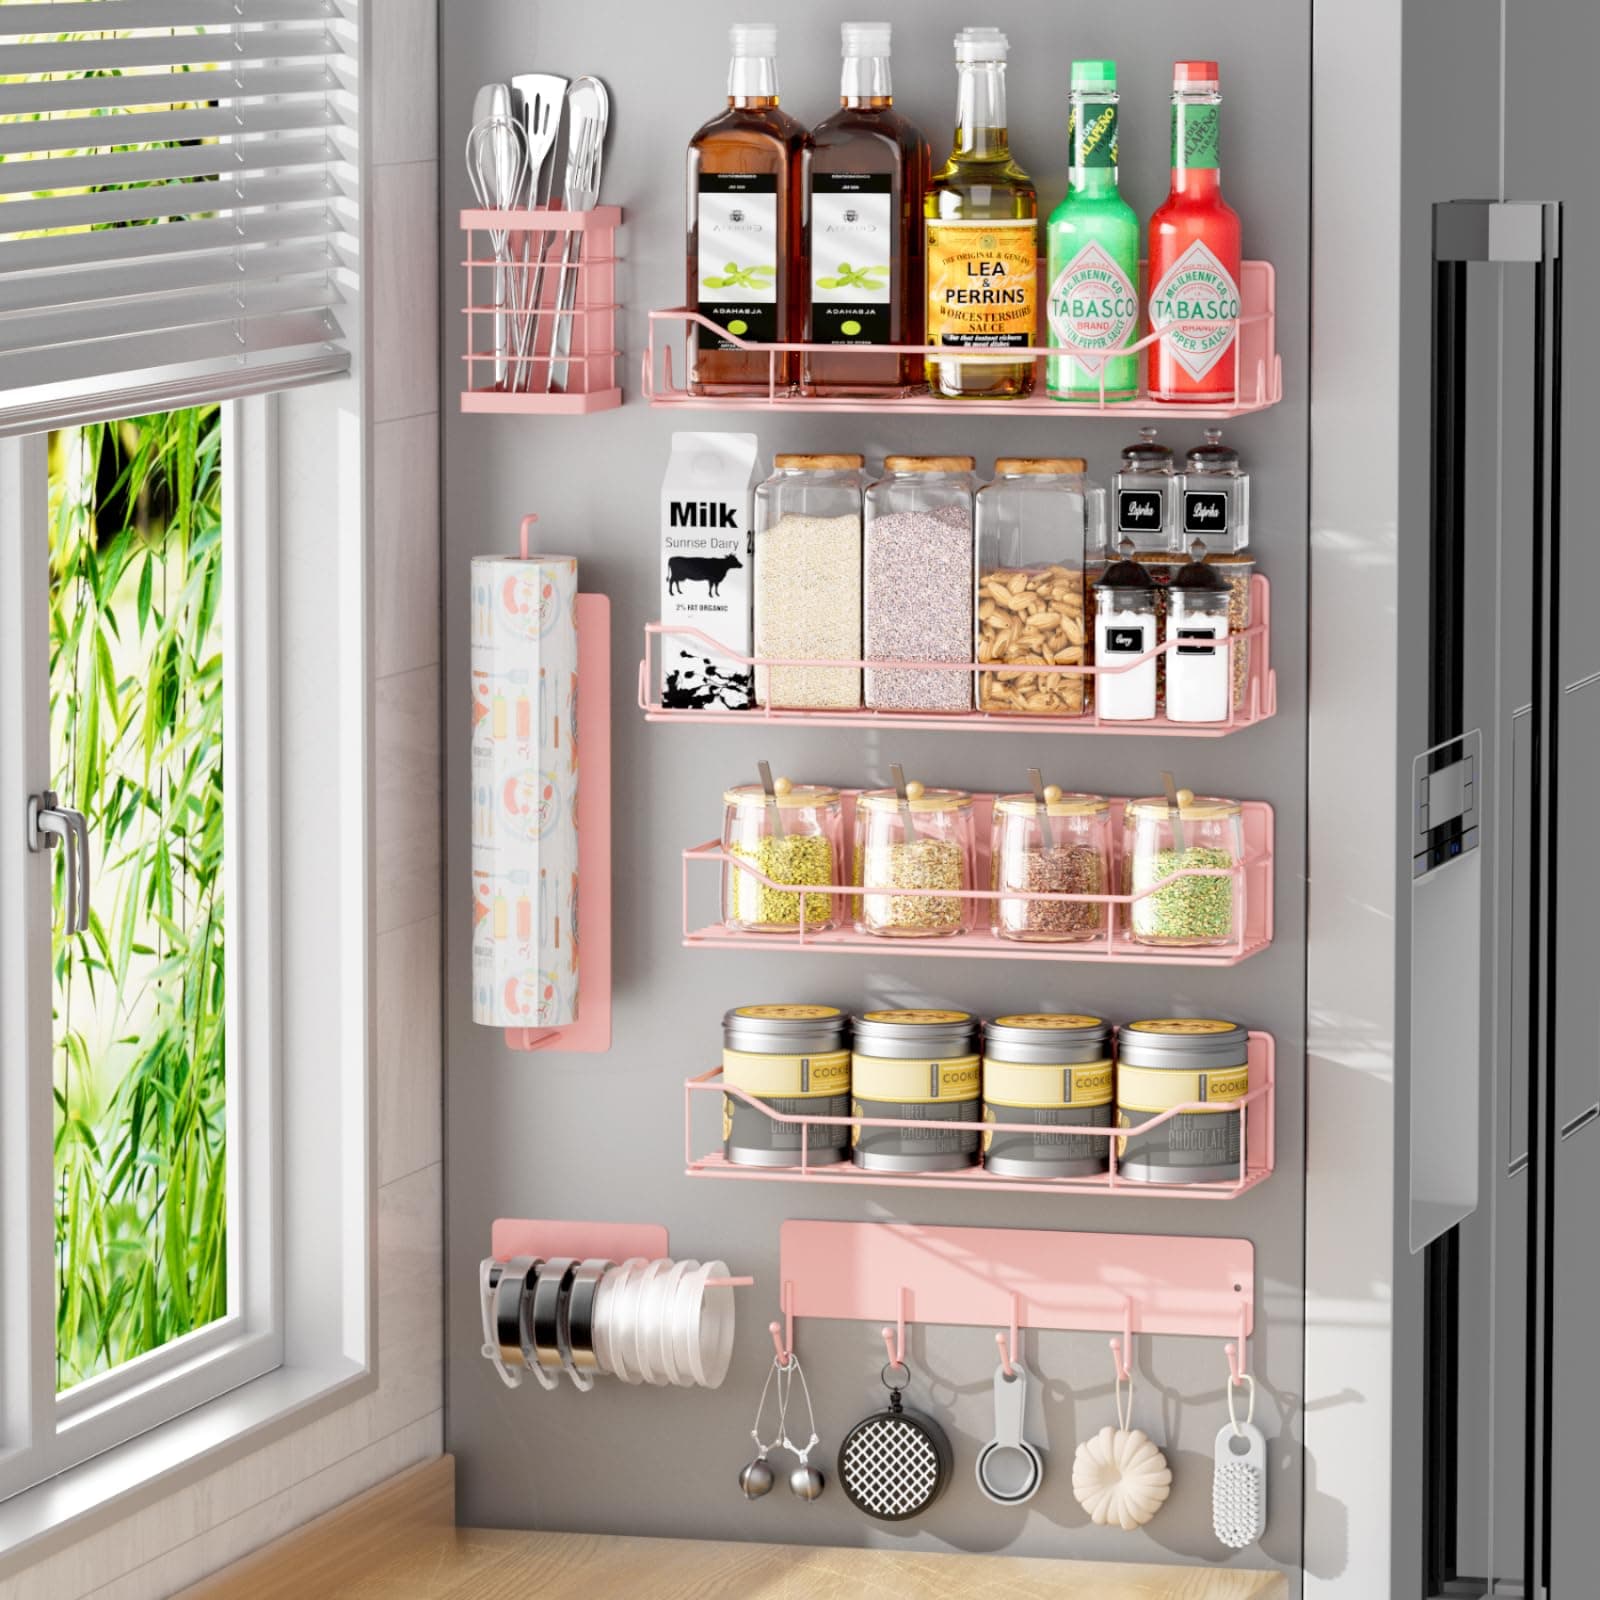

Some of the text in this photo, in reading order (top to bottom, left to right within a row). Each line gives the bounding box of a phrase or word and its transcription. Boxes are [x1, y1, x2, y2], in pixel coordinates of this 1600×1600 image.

[967, 262, 1006, 277] LEA
[982, 278, 991, 288] &
[945, 289, 1025, 304] PERRINS
[940, 305, 1032, 323] WORCESTERSHIRE
[1052, 298, 1136, 319] TABASCO
[1155, 299, 1239, 320] TABASCO
[968, 323, 1006, 333] SAUCE
[1076, 321, 1110, 331] BRAND
[670, 502, 739, 528] Milk
[665, 537, 739, 552] Sunrise Dairy
